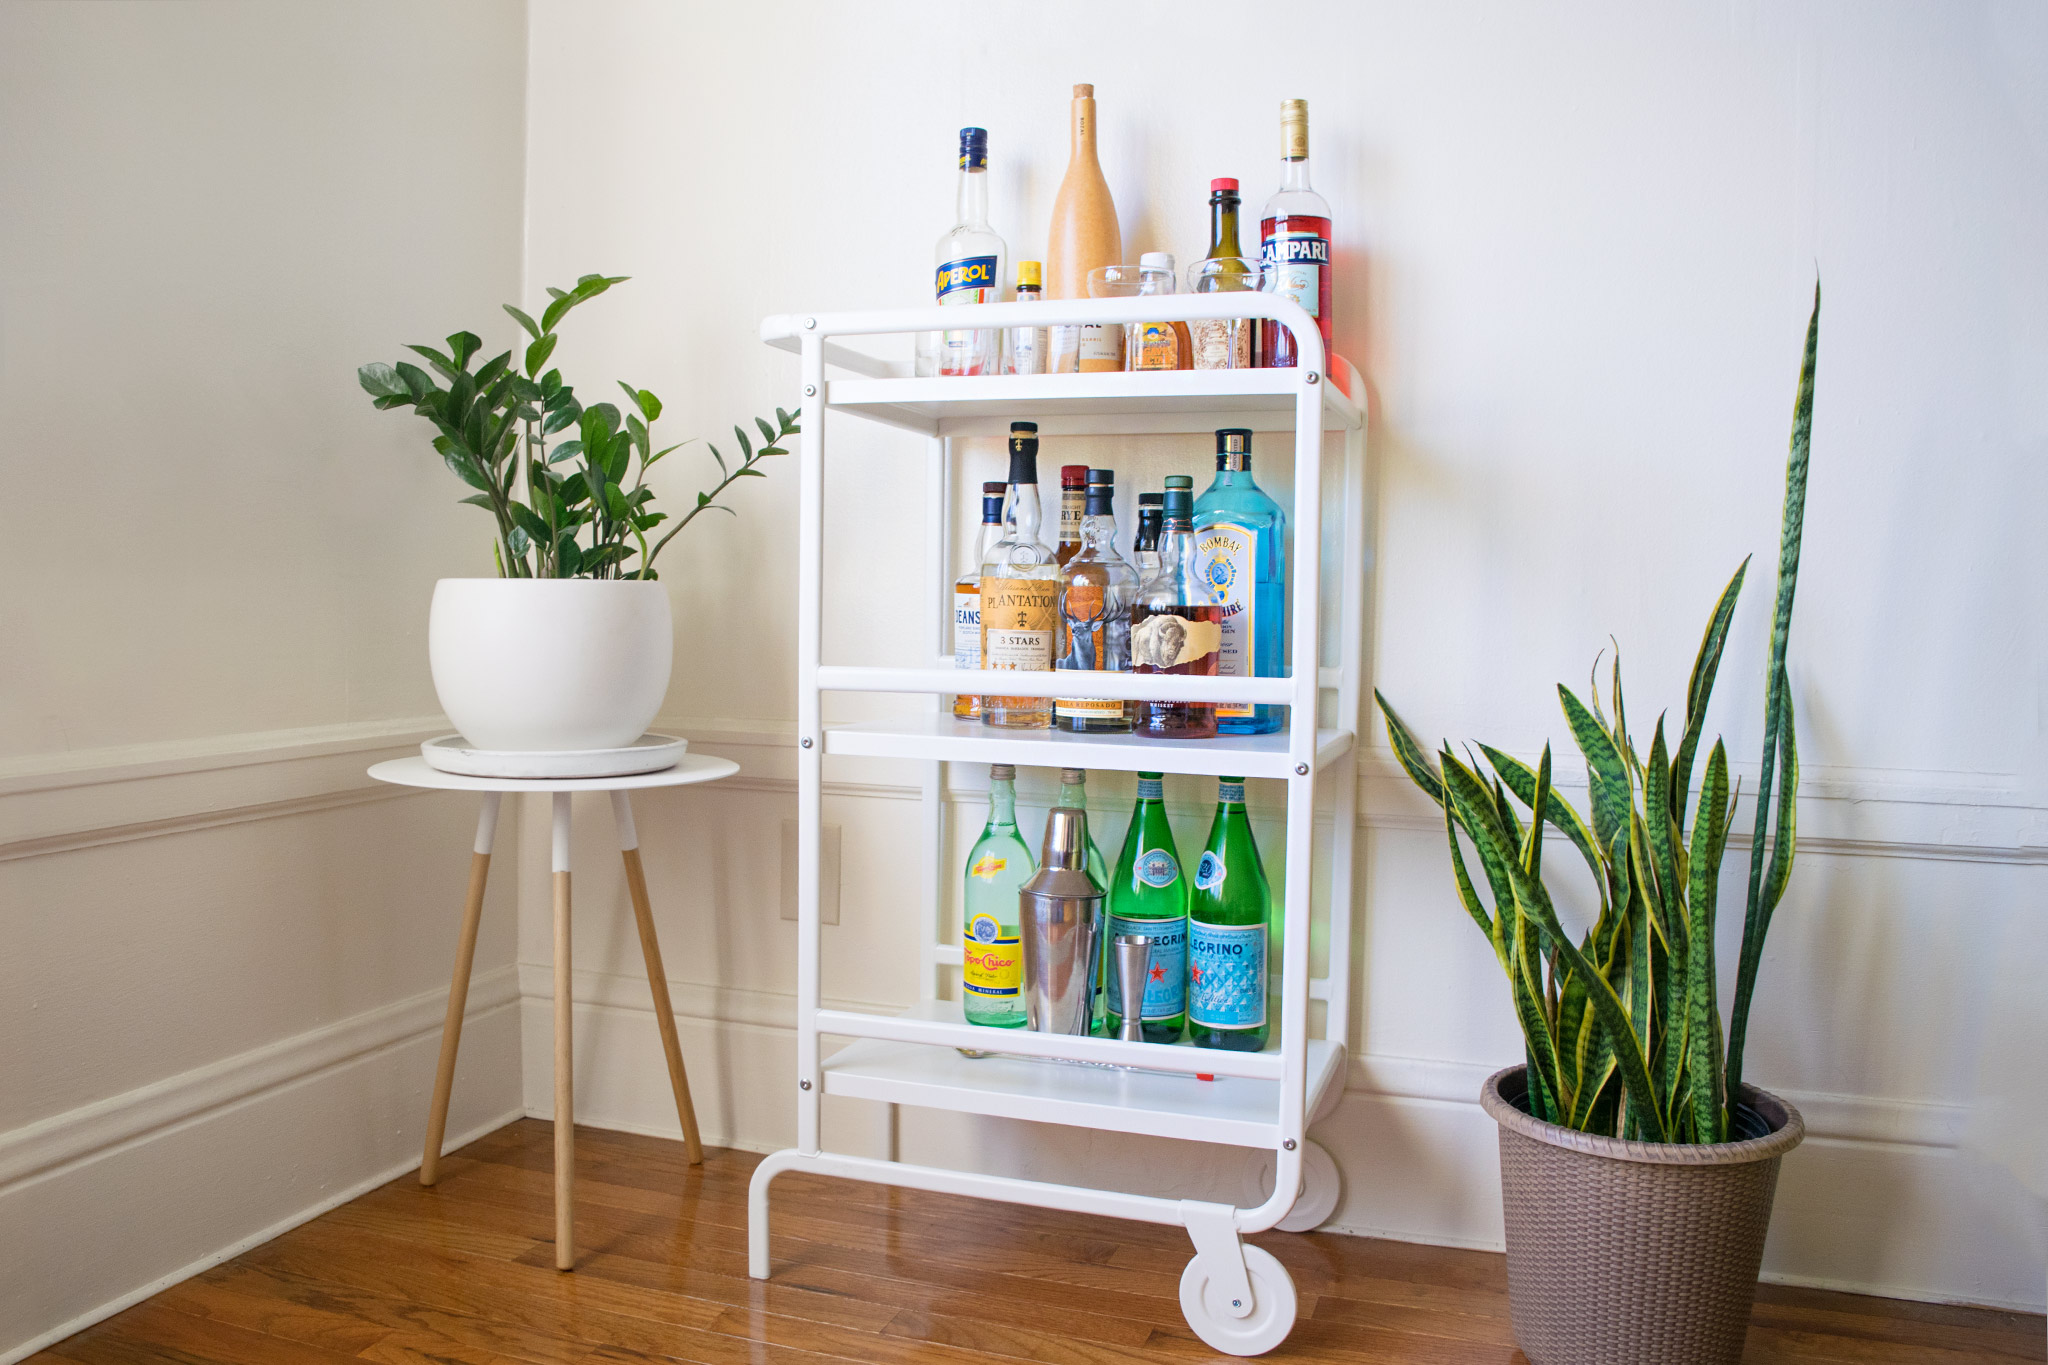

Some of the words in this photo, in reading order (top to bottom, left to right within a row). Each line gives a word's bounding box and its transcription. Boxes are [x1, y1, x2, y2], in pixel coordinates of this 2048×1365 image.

[936, 264, 990, 294] APEROL
[1061, 510, 1081, 521] RYE
[1199, 536, 1242, 553] BOMBAY
[987, 594, 1056, 608] PLANTATION
[1222, 600, 1243, 616] HIRE
[956, 610, 980, 624] EANS
[1000, 636, 1006, 645] 3
[1009, 637, 1040, 645] STARS
[1154, 933, 1187, 945] EGRIN
[981, 953, 1015, 971] Chico
